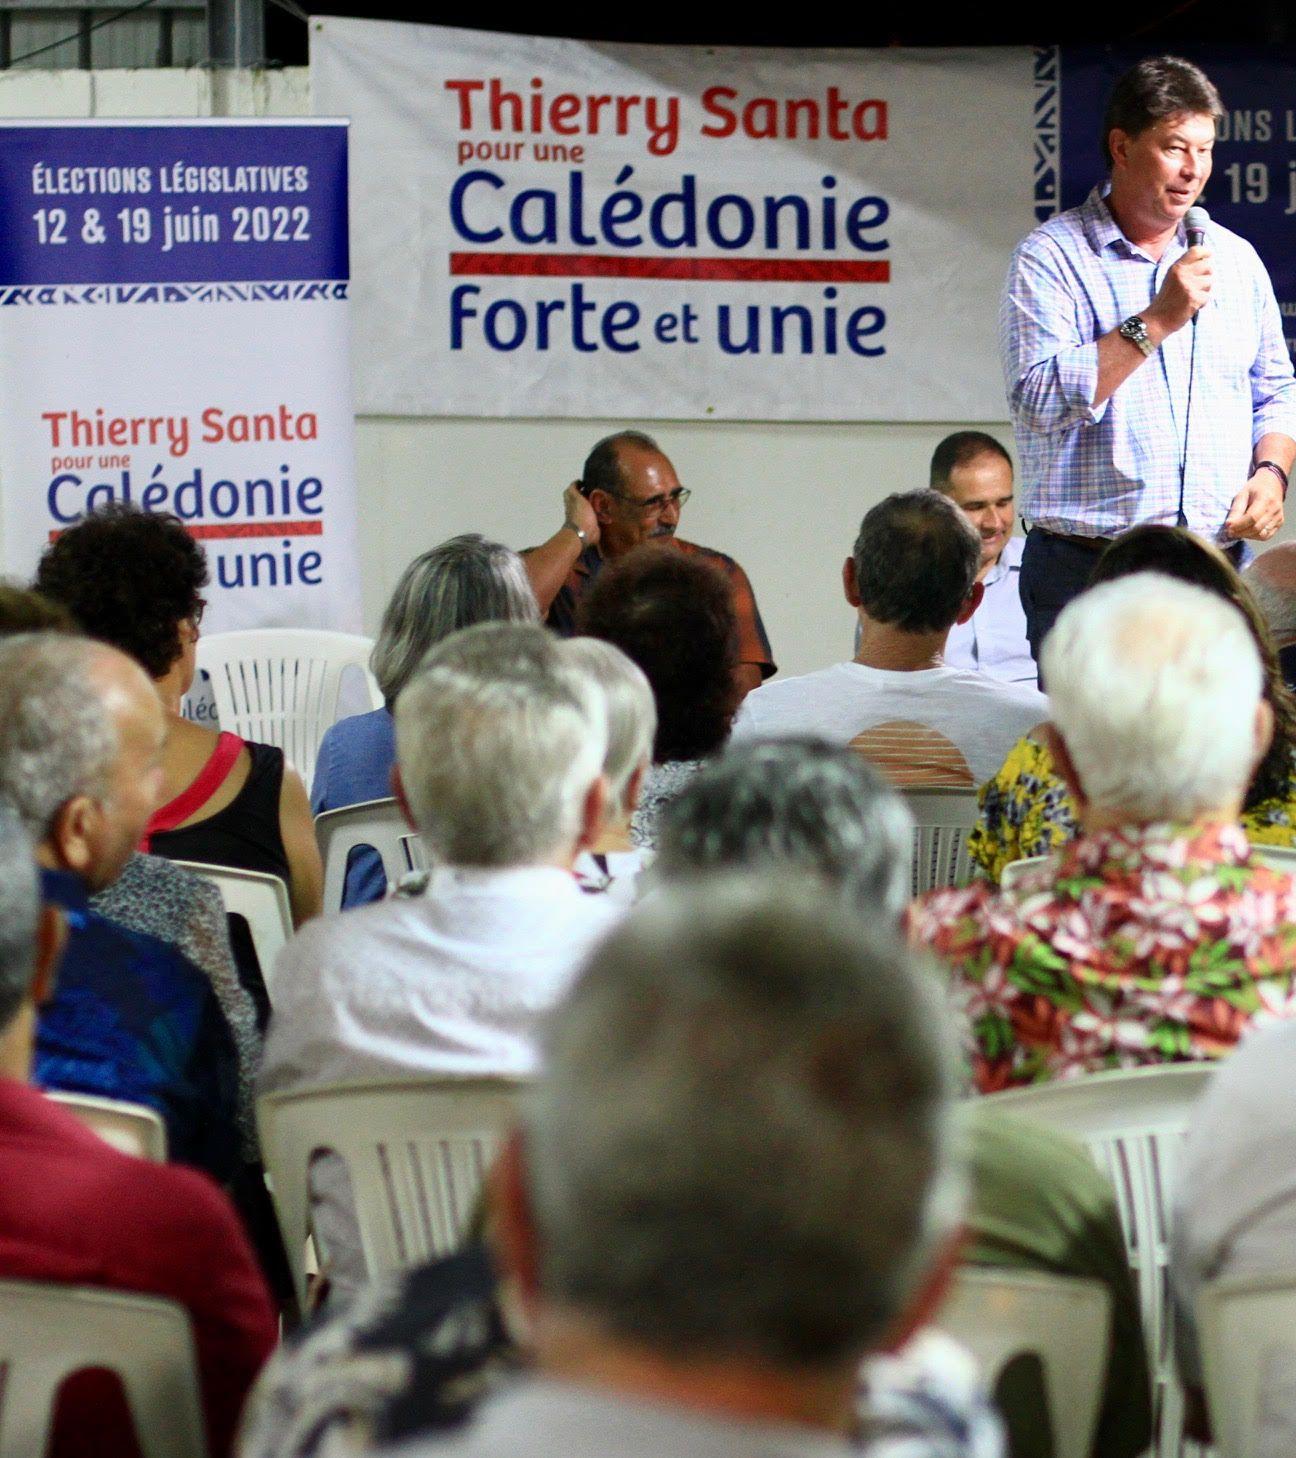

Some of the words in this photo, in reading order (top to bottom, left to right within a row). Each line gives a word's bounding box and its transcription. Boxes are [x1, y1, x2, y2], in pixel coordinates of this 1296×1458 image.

[444, 77, 680, 157] Thierry
[700, 86, 889, 142] Santa
[1216, 109, 1272, 142] ONS
[32, 161, 152, 194] ÉLECTIONS
[160, 160, 309, 193] LÉGISLATIVES
[457, 140, 524, 166] pour
[533, 141, 584, 164] une
[1224, 162, 1269, 204] 19
[32, 208, 68, 245] 12
[81, 207, 106, 244] &
[117, 207, 151, 244] 19
[161, 205, 220, 252] juin
[231, 205, 311, 242] 2022
[449, 165, 891, 253] Calédonie
[449, 283, 642, 353] forte
[653, 303, 700, 345] et
[717, 287, 887, 358] unie
[41, 408, 190, 458] Thierry
[202, 404, 318, 444] Santa
[52, 455, 94, 475] pour
[98, 454, 131, 469] une
[47, 463, 324, 524] Calédonie
[217, 539, 323, 589] unie
